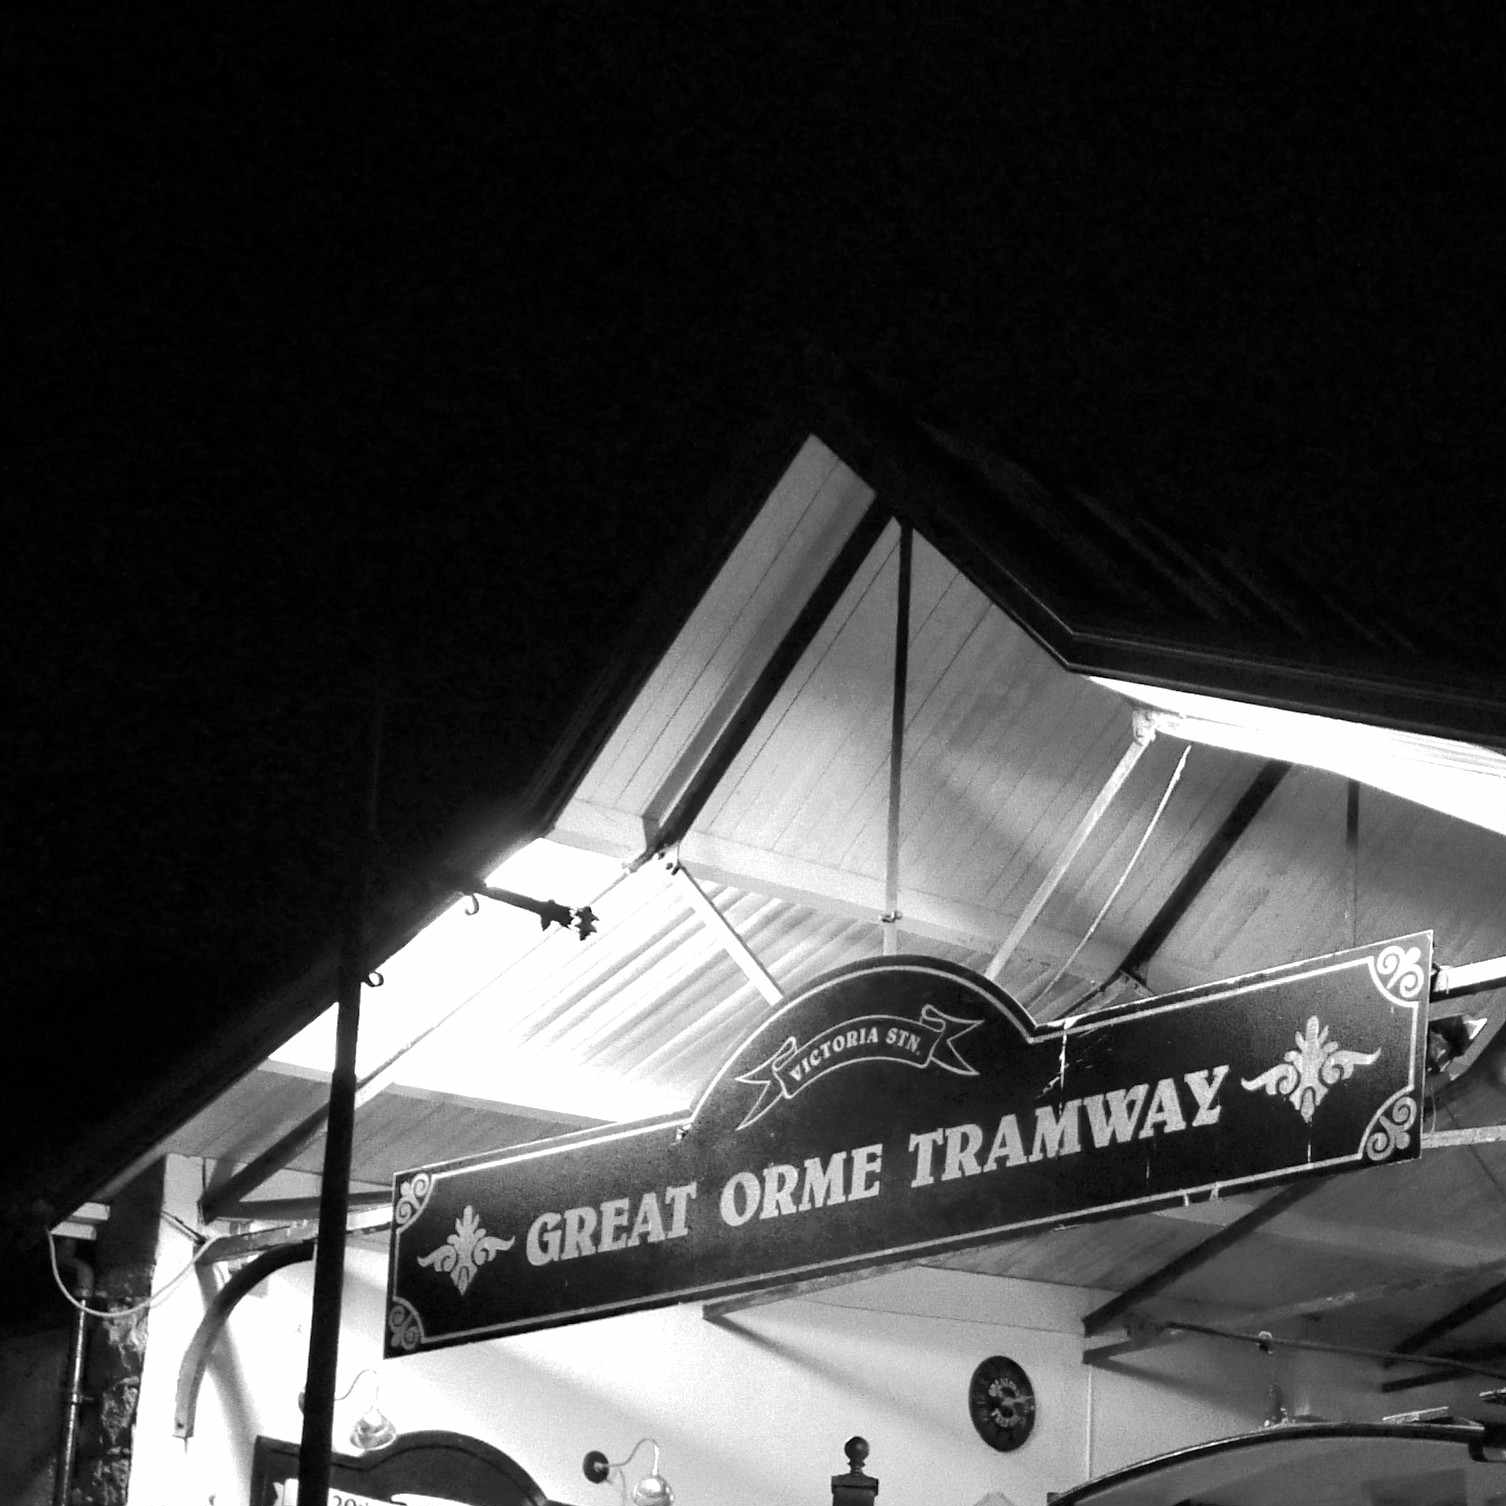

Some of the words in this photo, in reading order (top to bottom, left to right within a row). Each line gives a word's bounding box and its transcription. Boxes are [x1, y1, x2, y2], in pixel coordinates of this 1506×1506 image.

[789, 1027, 879, 1081] VICTORIA
[886, 1027, 921, 1056] STN.
[526, 1181, 697, 1268] GREAT
[719, 1144, 884, 1228] ORME
[909, 1064, 1229, 1188] TRAMWAY
